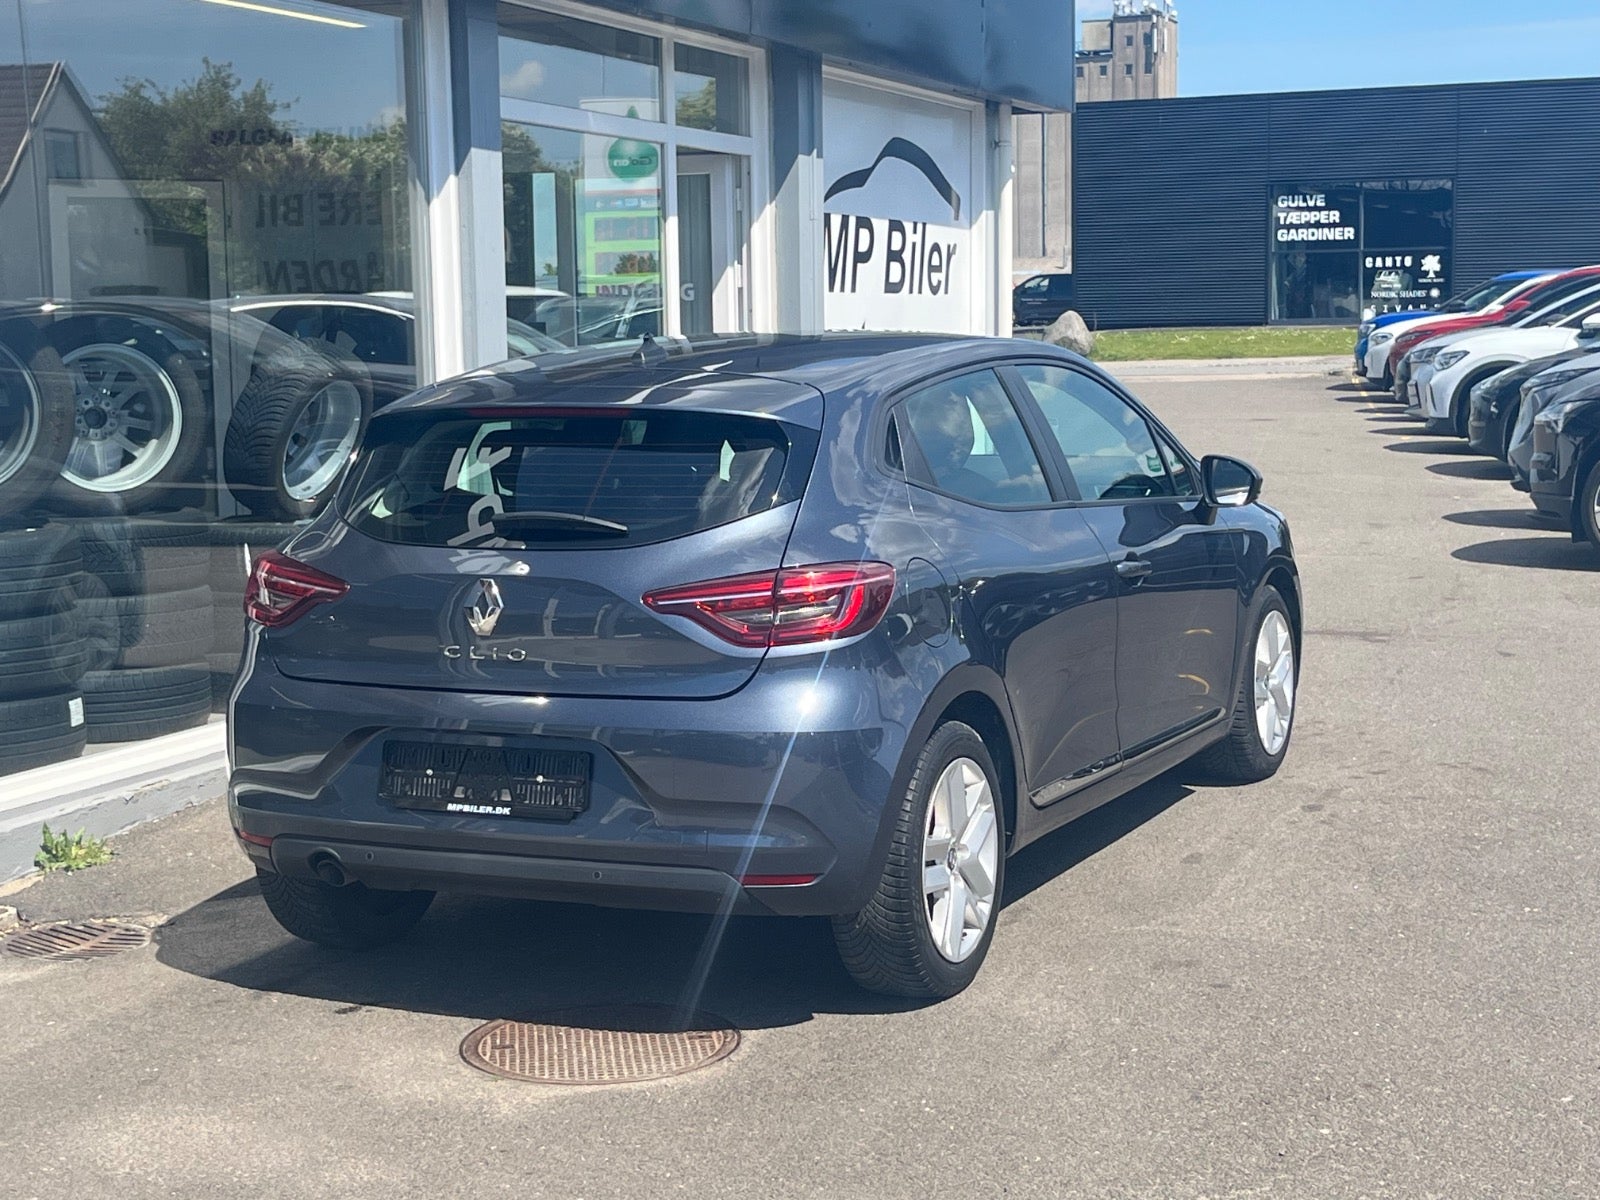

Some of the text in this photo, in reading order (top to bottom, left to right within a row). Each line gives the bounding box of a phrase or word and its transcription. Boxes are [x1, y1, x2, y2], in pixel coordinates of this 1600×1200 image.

[1277, 194, 1326, 208] GULVE
[1277, 210, 1340, 225] TÆPPER
[1277, 227, 1355, 242] GARDINER
[823, 212, 957, 296] MP Biler
[443, 645, 526, 661] CLIO
[446, 803, 511, 815] MPBILER.DK
